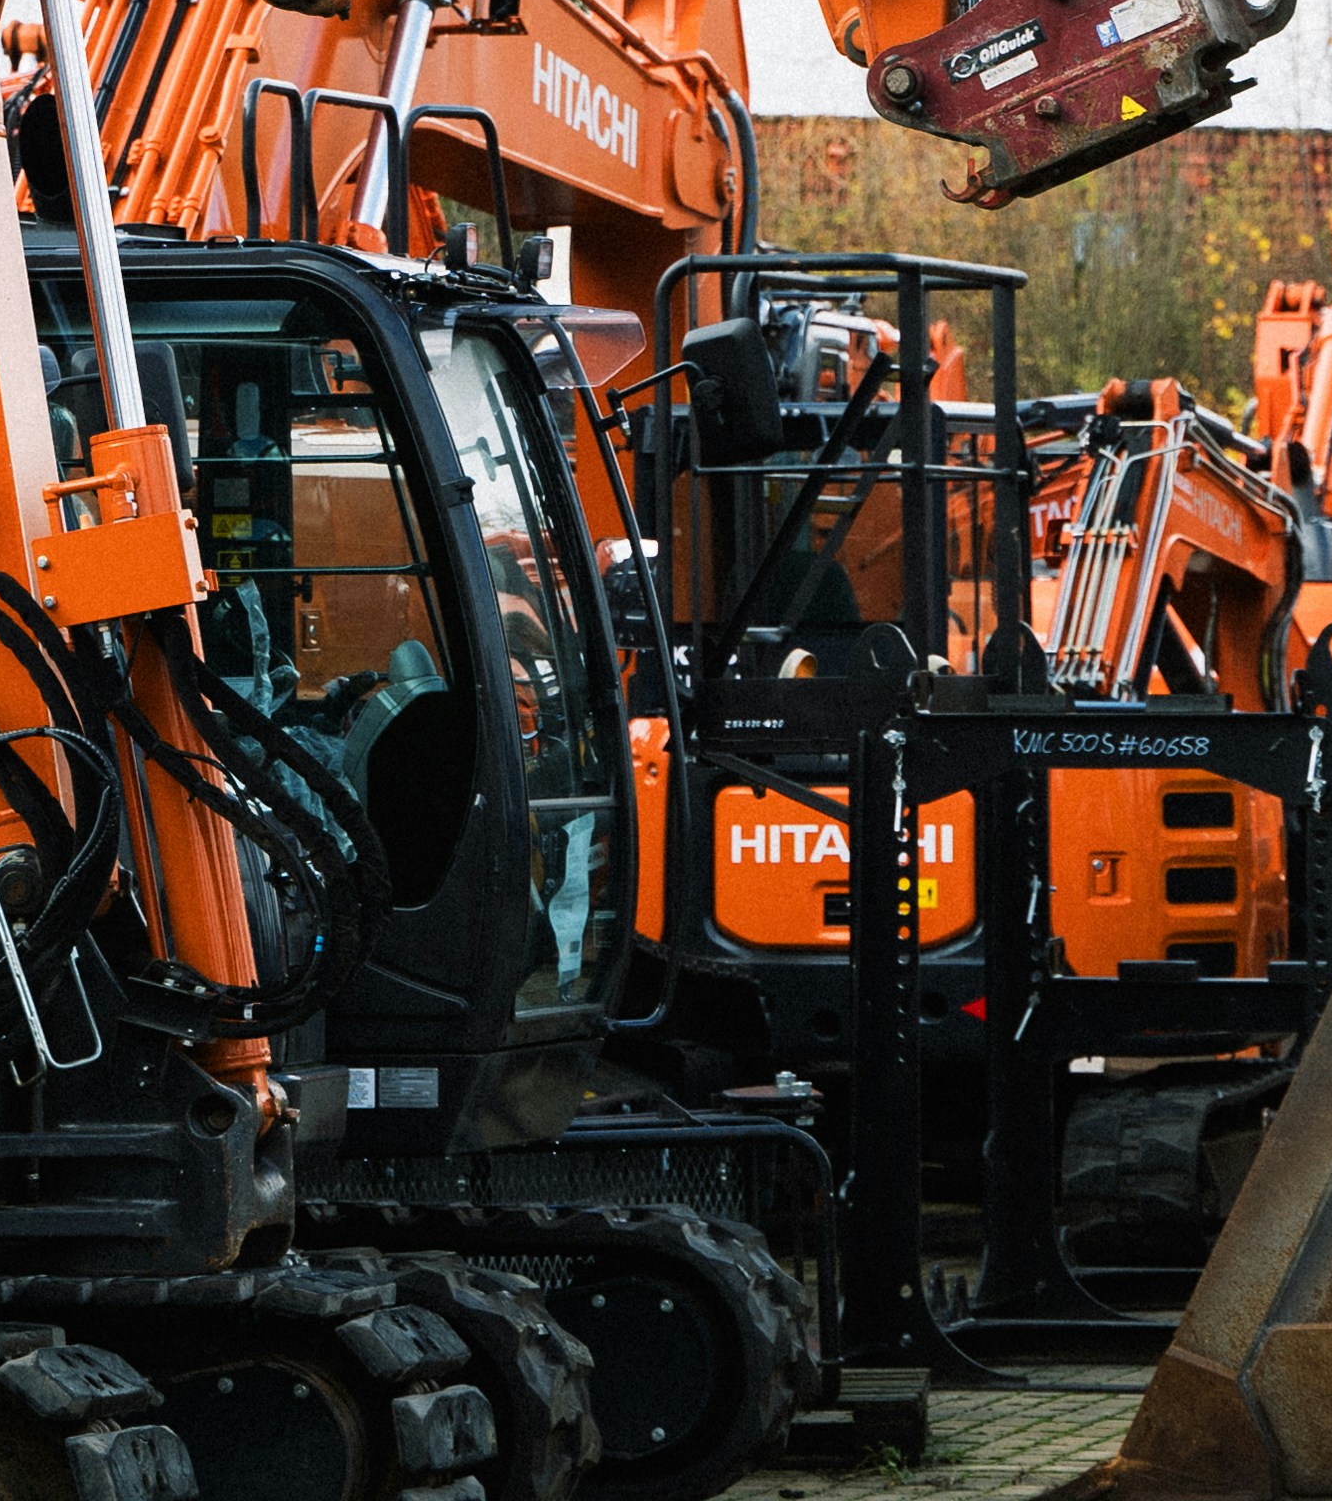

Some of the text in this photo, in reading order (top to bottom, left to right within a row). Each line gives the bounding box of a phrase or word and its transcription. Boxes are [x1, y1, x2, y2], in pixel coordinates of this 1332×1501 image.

[979, 27, 1036, 64] OilQuick
[532, 41, 639, 169] HITACHI
[1013, 728, 1056, 754] KMC
[1118, 734, 1210, 757] #60658
[731, 824, 954, 864] HITAHI
